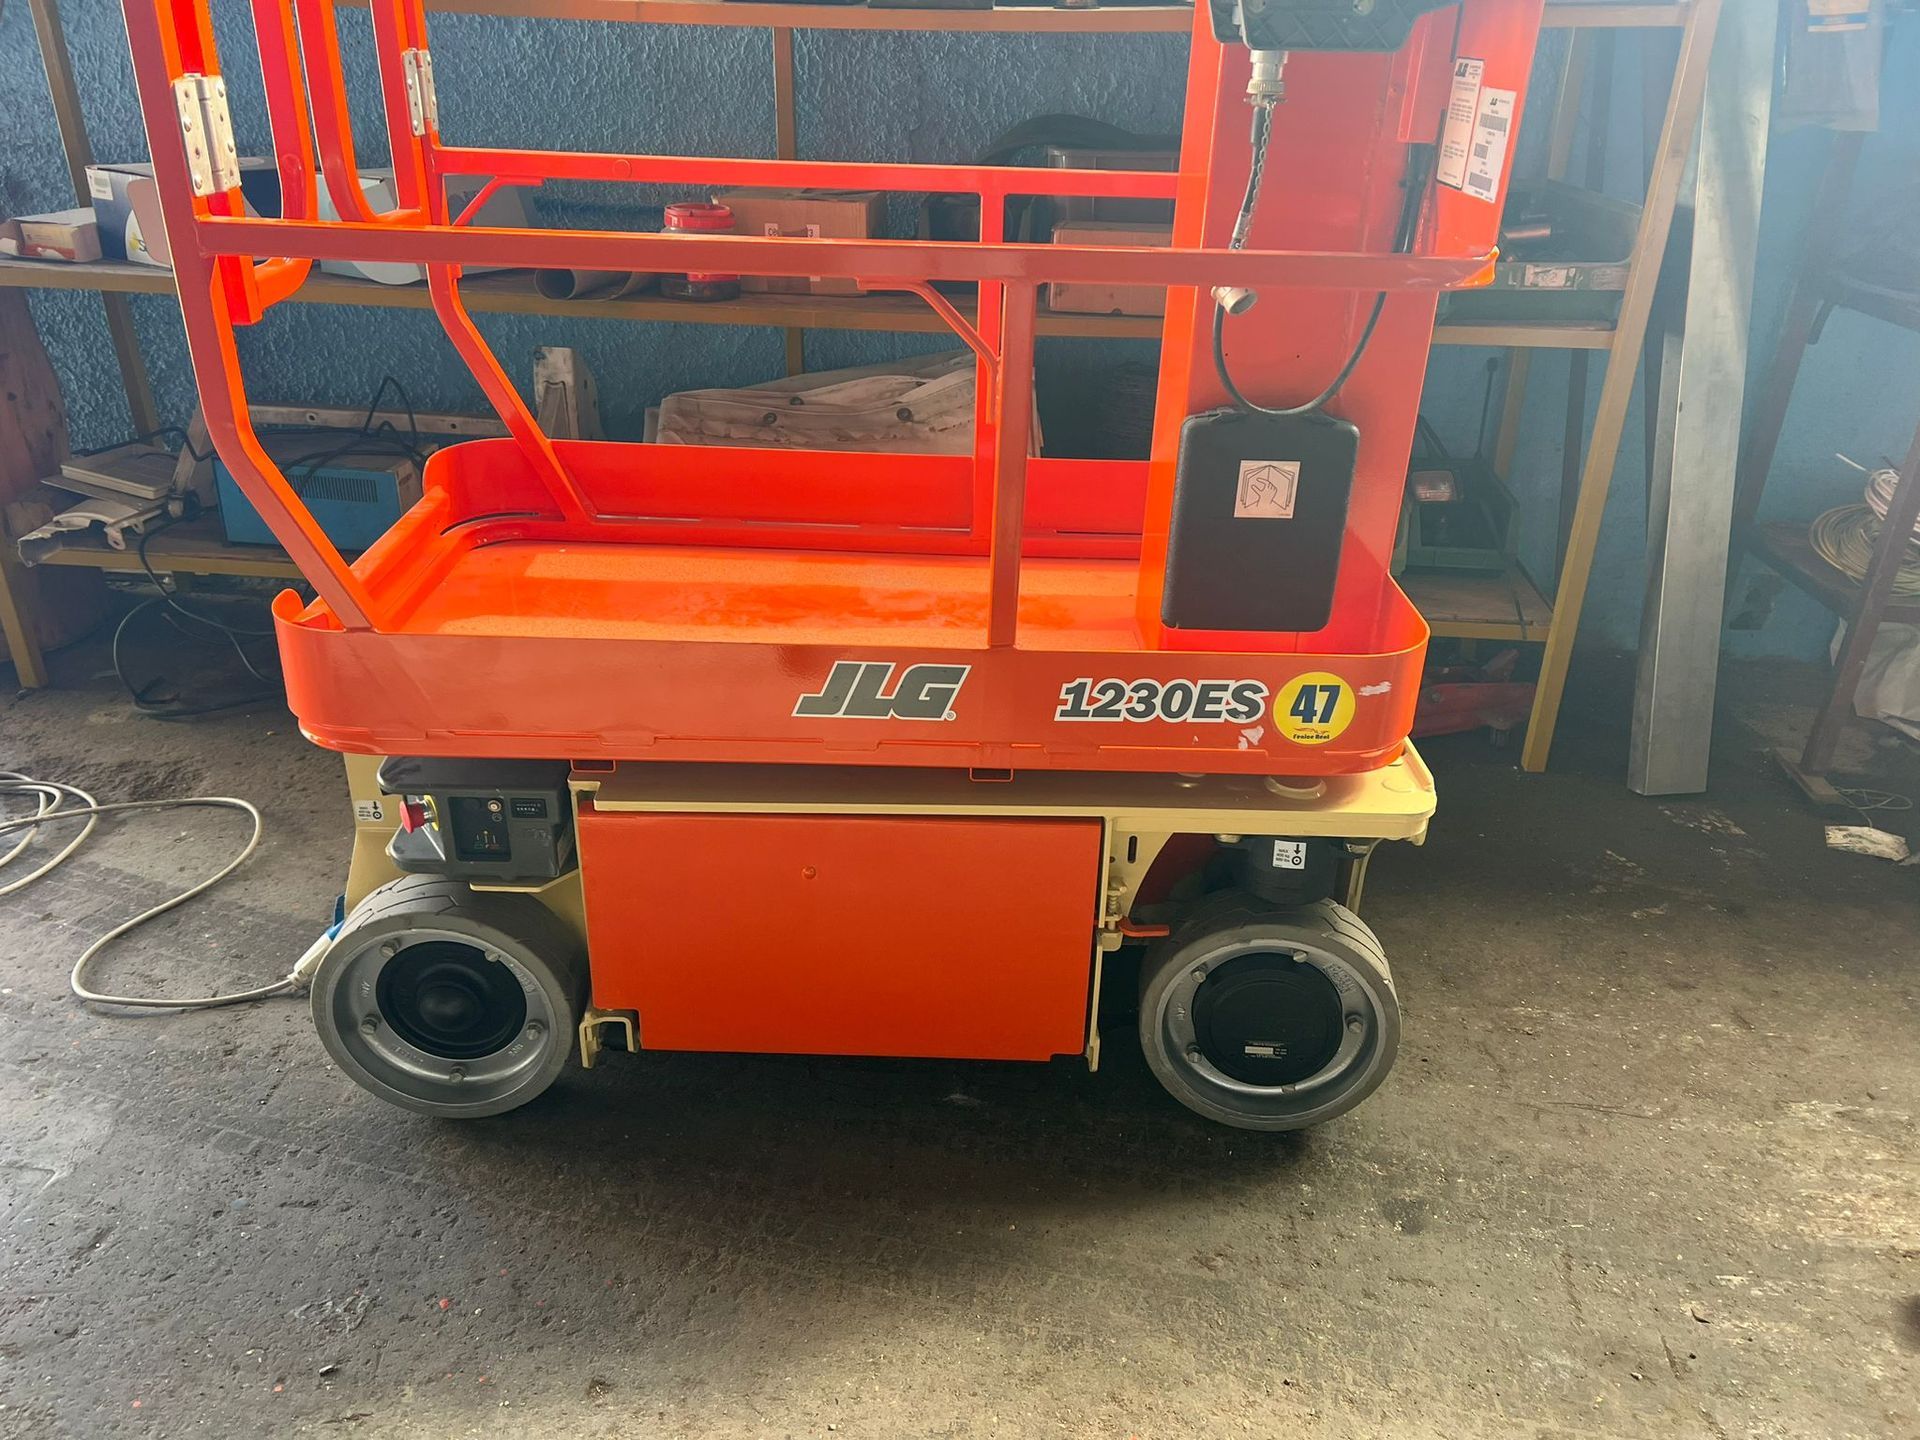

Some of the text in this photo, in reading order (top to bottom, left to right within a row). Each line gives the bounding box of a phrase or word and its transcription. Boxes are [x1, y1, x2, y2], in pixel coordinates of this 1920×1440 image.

[791, 661, 971, 721] JLG
[1054, 678, 1270, 724] 1230ES
[1290, 684, 1341, 723] 47
